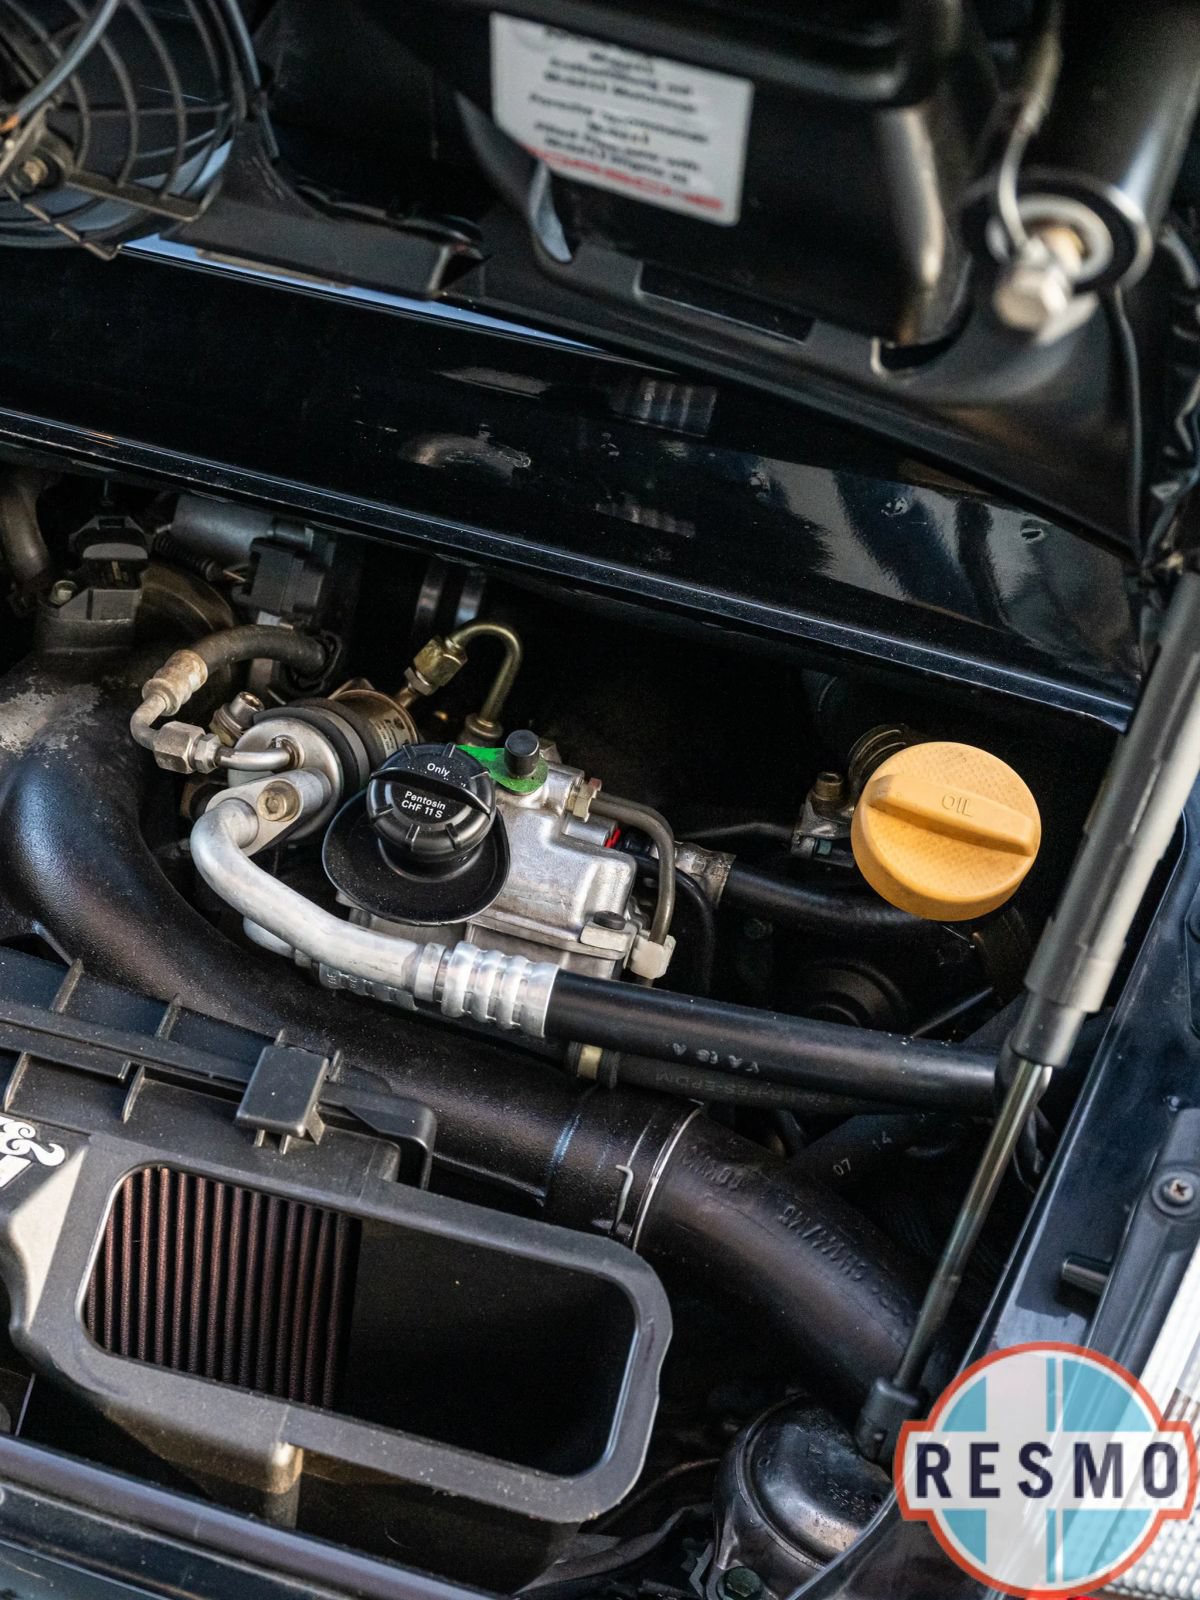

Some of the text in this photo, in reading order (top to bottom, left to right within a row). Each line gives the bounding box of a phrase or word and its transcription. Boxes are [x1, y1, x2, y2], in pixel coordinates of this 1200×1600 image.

[427, 763, 450, 777] Only
[404, 791, 446, 809] Pentosin
[941, 793, 974, 817] OIL
[401, 800, 443, 819] CHF 11 S
